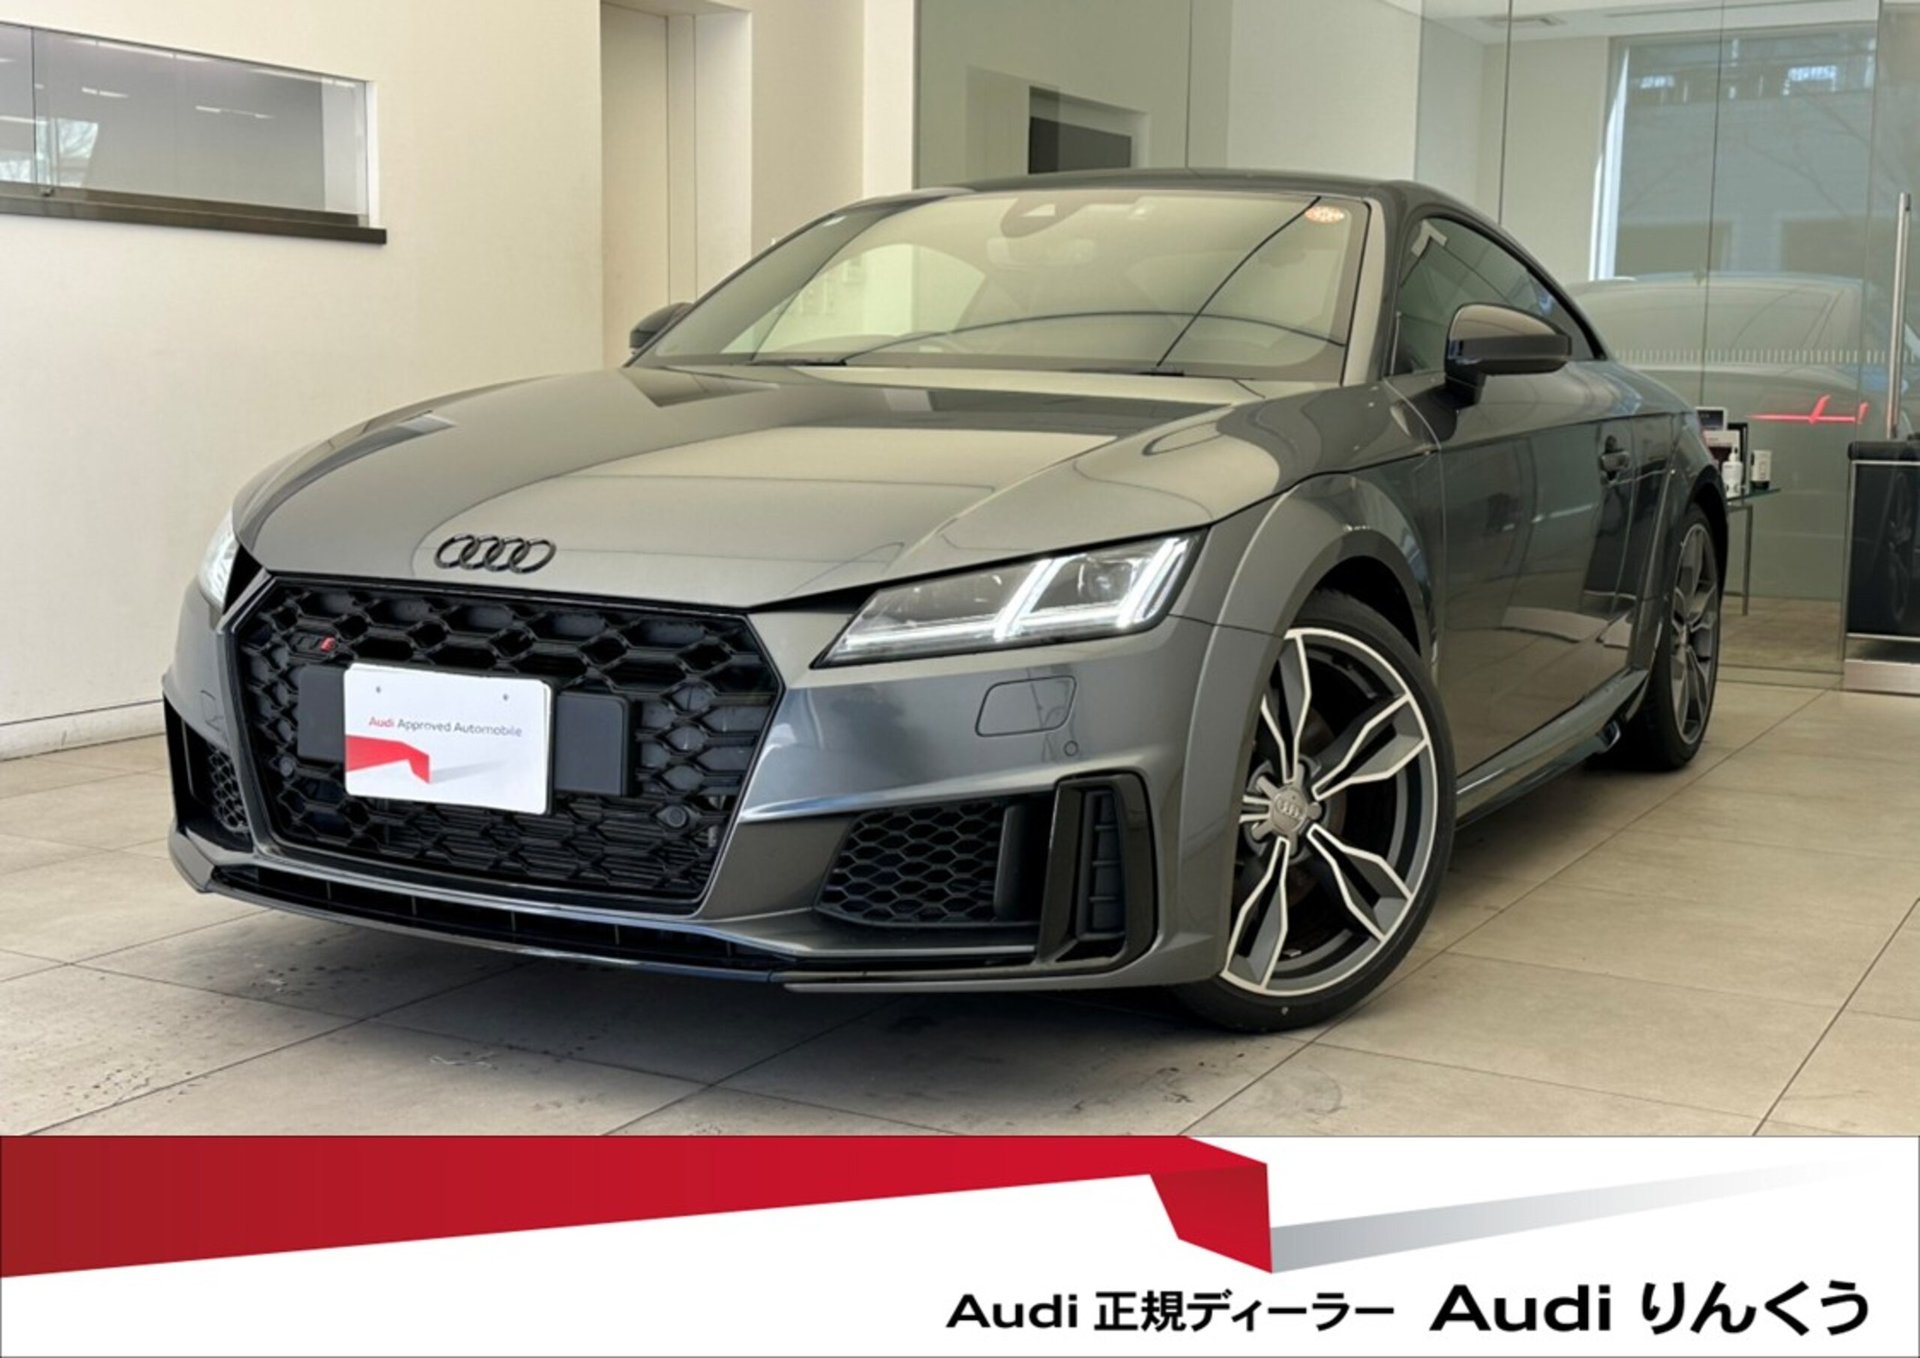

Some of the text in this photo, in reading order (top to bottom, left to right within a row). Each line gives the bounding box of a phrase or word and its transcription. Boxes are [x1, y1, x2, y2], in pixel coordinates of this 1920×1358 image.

[368, 716, 523, 738] Audi Approved Automobile
